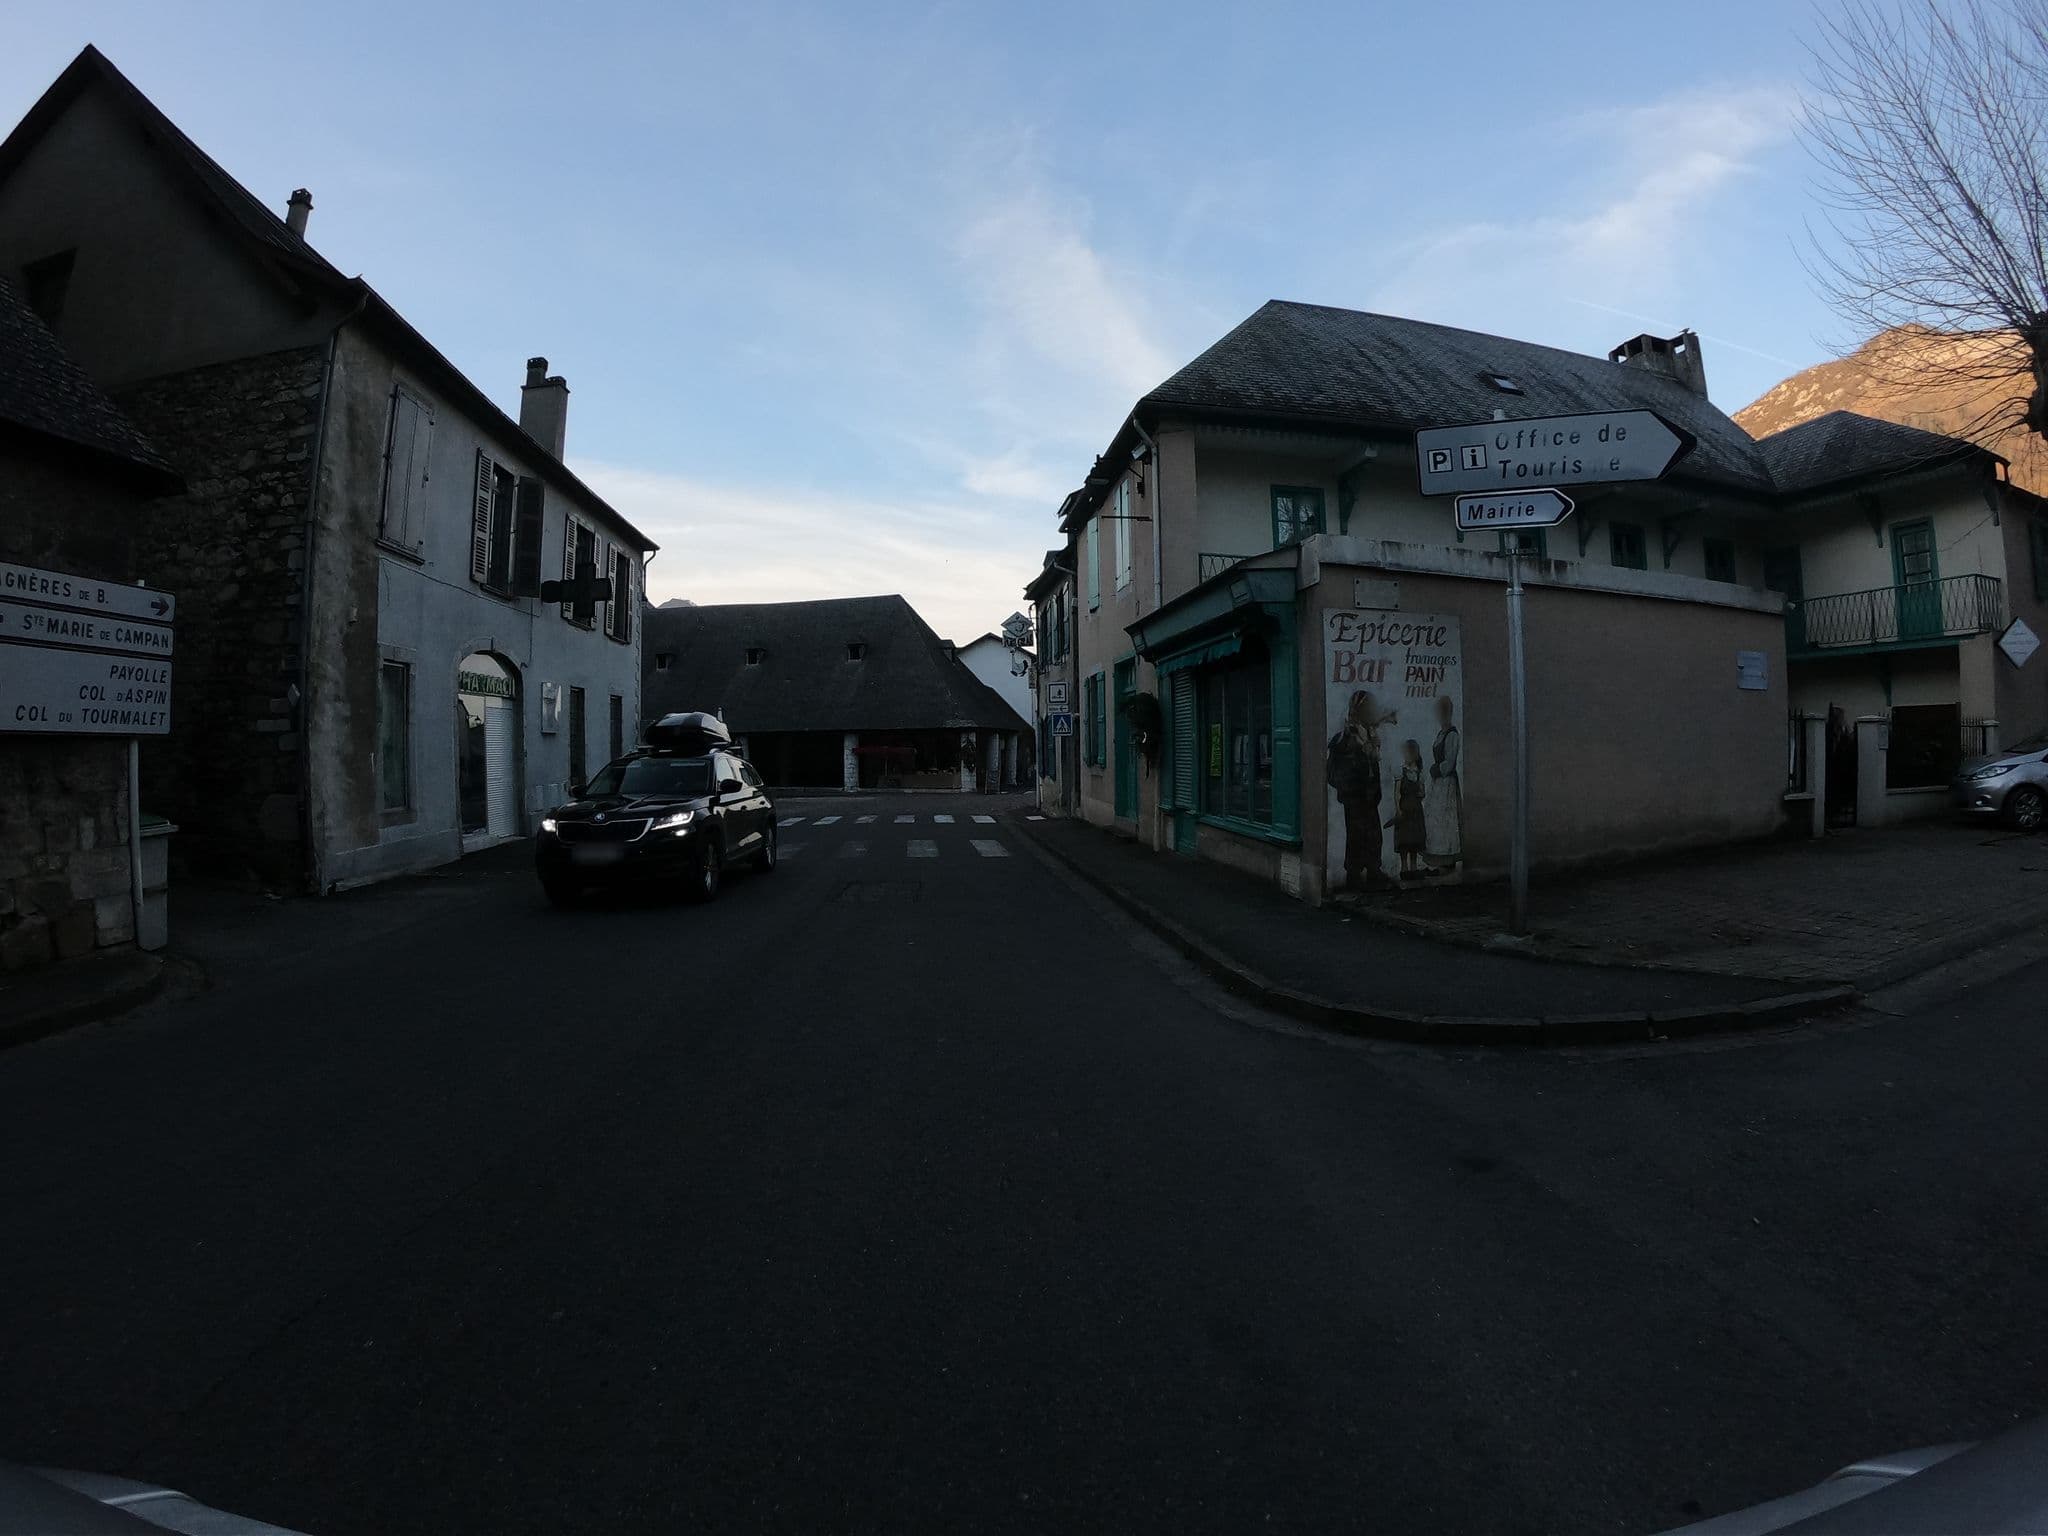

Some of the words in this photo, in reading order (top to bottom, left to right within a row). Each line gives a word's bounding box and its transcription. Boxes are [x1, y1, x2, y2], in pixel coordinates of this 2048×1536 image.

[1598, 423, 1627, 443] de
[1498, 455, 1620, 479] Tourise
[1467, 501, 1536, 520] Mairie
[0, 572, 72, 598] GNÈRES
[79, 589, 90, 601] DE
[97, 588, 109, 604] B.
[47, 617, 94, 639] MARIE
[100, 630, 111, 641] DE
[115, 627, 169, 649] CAMPAN
[1329, 612, 1447, 655] Epicerie
[1331, 650, 1392, 684] Bar
[1405, 648, 1457, 670] fromages
[109, 664, 167, 684] PAYOLLE
[1404, 666, 1445, 683] PAIN
[79, 684, 106, 701] COL
[15, 705, 48, 722] COL
[58, 712, 73, 723] DU
[81, 708, 166, 726] TOURMALET
